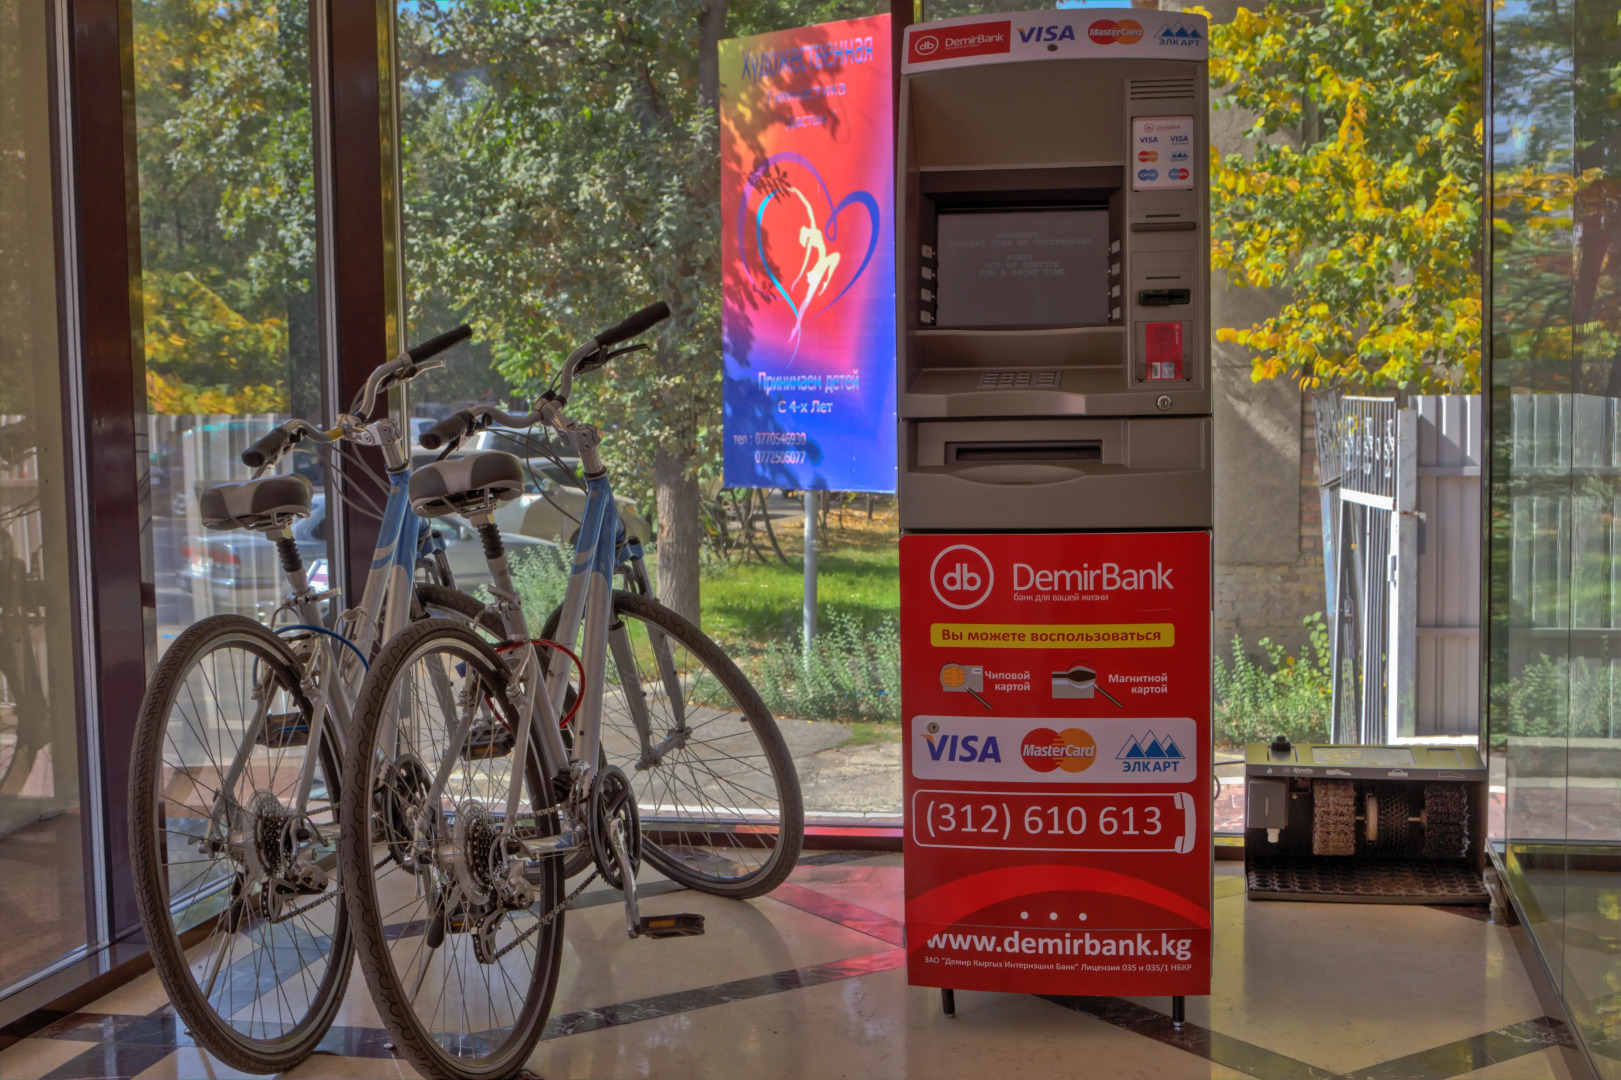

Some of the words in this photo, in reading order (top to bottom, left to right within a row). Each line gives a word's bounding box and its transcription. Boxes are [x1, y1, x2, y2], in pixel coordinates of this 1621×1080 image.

[1014, 25, 1075, 43] VISA
[1090, 28, 1142, 36] MasterCard
[920, 41, 934, 50] db
[945, 33, 1004, 47] DemirBank
[1159, 38, 1200, 46] ЭЛКАРТ
[742, 36, 873, 86] Художественная
[767, 82, 846, 104] Гимнастика
[758, 372, 822, 396] Принимаем
[825, 368, 860, 393] детей
[789, 400, 808, 413] 4-х
[810, 400, 833, 413] Лет
[755, 432, 806, 445] 0770546930
[942, 563, 981, 591] db
[1013, 562, 1174, 591] DemirBank
[1014, 593, 1033, 601] банк
[1052, 593, 1079, 601] вашей
[942, 629, 963, 641] Вы
[968, 631, 1026, 642] можете
[1031, 630, 1161, 642] воспользоваться
[985, 670, 1030, 681] Чиповой
[1108, 673, 1168, 683] Магнитной
[994, 682, 1030, 693] картой
[1131, 684, 1168, 695] картой
[920, 734, 1002, 763] VISA
[1022, 744, 1095, 758] MasterCard
[1122, 761, 1180, 772] ЭЛКАРТ
[926, 800, 1011, 840] (312)
[1024, 806, 1087, 835] 610
[1099, 806, 1162, 835] 613
[926, 931, 1192, 961] www.demirbank.kg
[924, 956, 940, 964] ЗАО
[973, 960, 1002, 968] Кыргыз
[1005, 962, 1054, 970] Интернэшнл
[1080, 964, 1120, 972] Лицензия
[1146, 964, 1168, 972] 035/1
